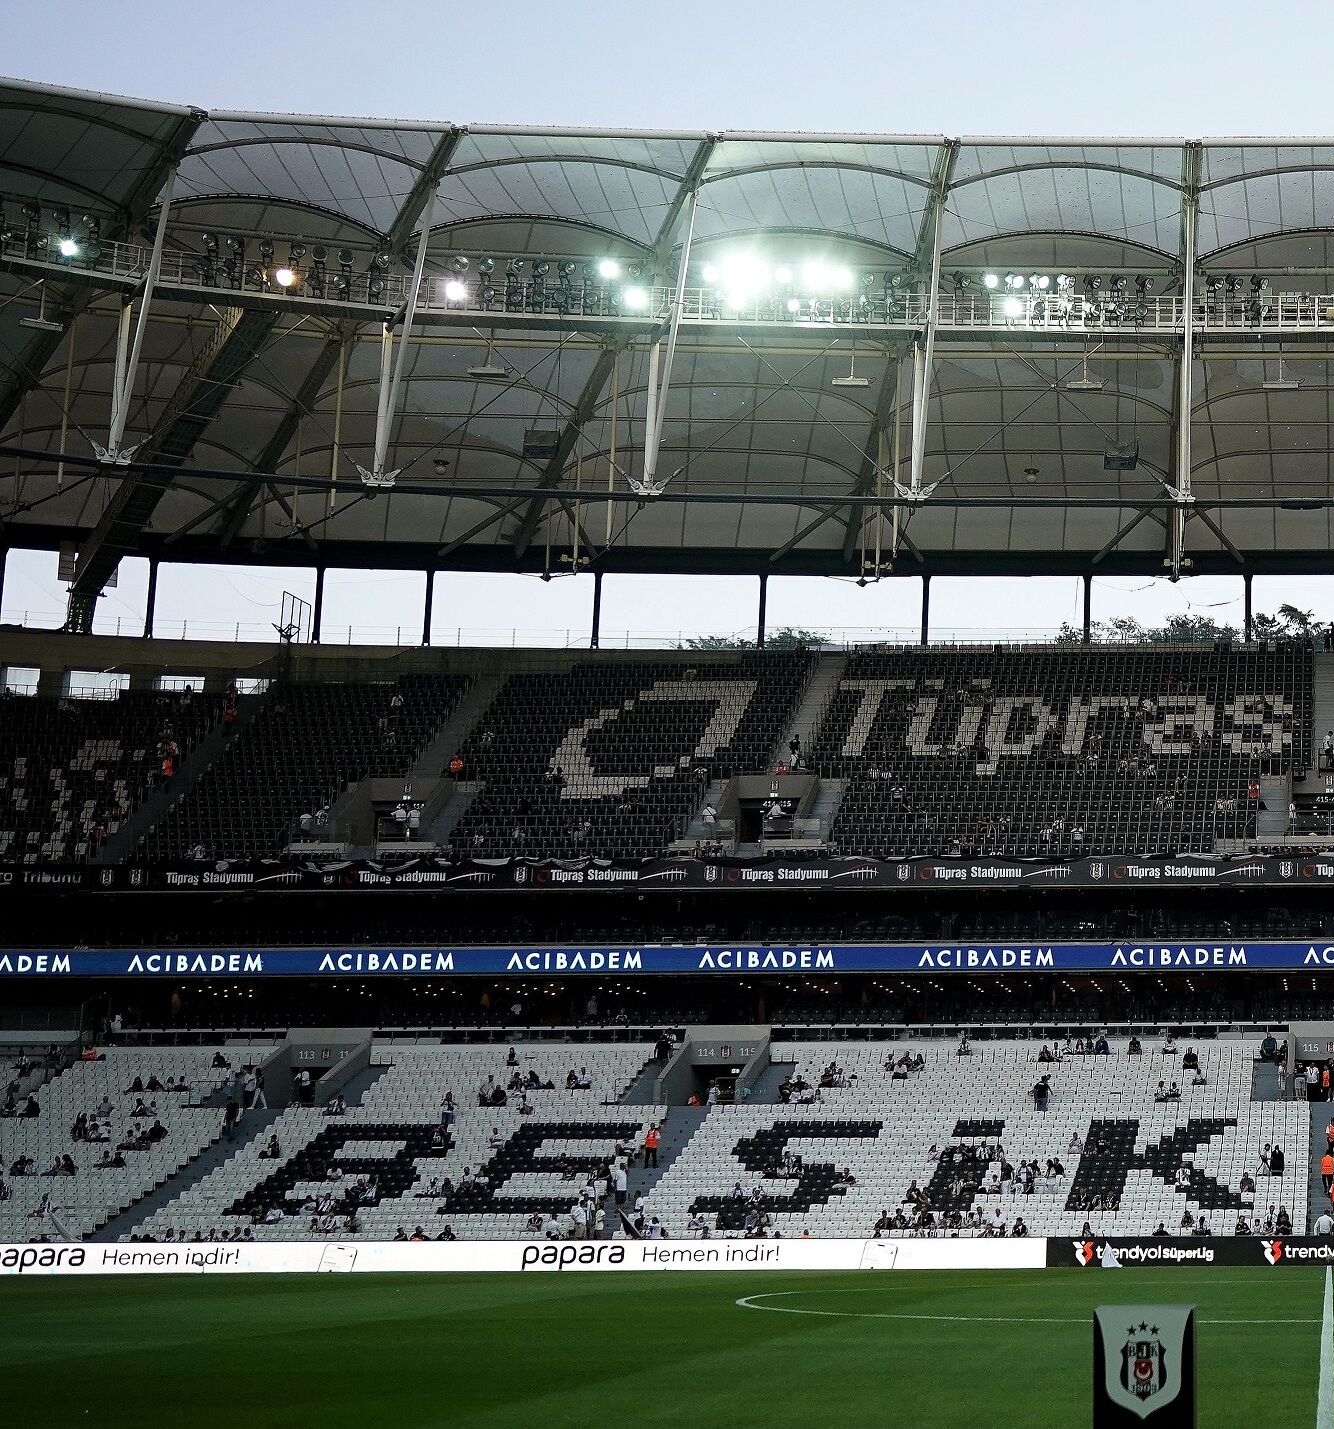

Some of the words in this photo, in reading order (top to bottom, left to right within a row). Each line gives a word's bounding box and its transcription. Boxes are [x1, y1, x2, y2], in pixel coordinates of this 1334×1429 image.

[203, 872, 253, 885] Stadyumu
[551, 869, 584, 882] Tüpraş
[588, 868, 638, 881] Stadyumu
[741, 869, 774, 882] Tüpraş
[777, 868, 828, 880] Stadyumu
[934, 867, 967, 880] Tüpraş
[971, 867, 1021, 879] Stadyumu
[1127, 866, 1161, 879] Tüpraş
[1165, 865, 1215, 878] Stadyumu
[128, 954, 263, 971] ACIBADEM
[319, 953, 453, 970] ACIBADEM
[507, 951, 641, 969] ACIBADEM
[699, 950, 833, 967] ACIBADEM
[918, 949, 1053, 966] ACIBADEM
[1111, 947, 1246, 965] ACIBADEM
[299, 1051, 315, 1059] 113
[698, 1048, 715, 1056] 114
[1303, 1044, 1319, 1052] 115
[0, 1247, 85, 1272] apara
[102, 1249, 179, 1265] Hemen
[185, 1248, 240, 1265] indir!
[522, 1245, 625, 1271] papara
[643, 1246, 719, 1262] Hemen
[726, 1245, 779, 1262] indir!
[1096, 1245, 1161, 1260] tendyol
